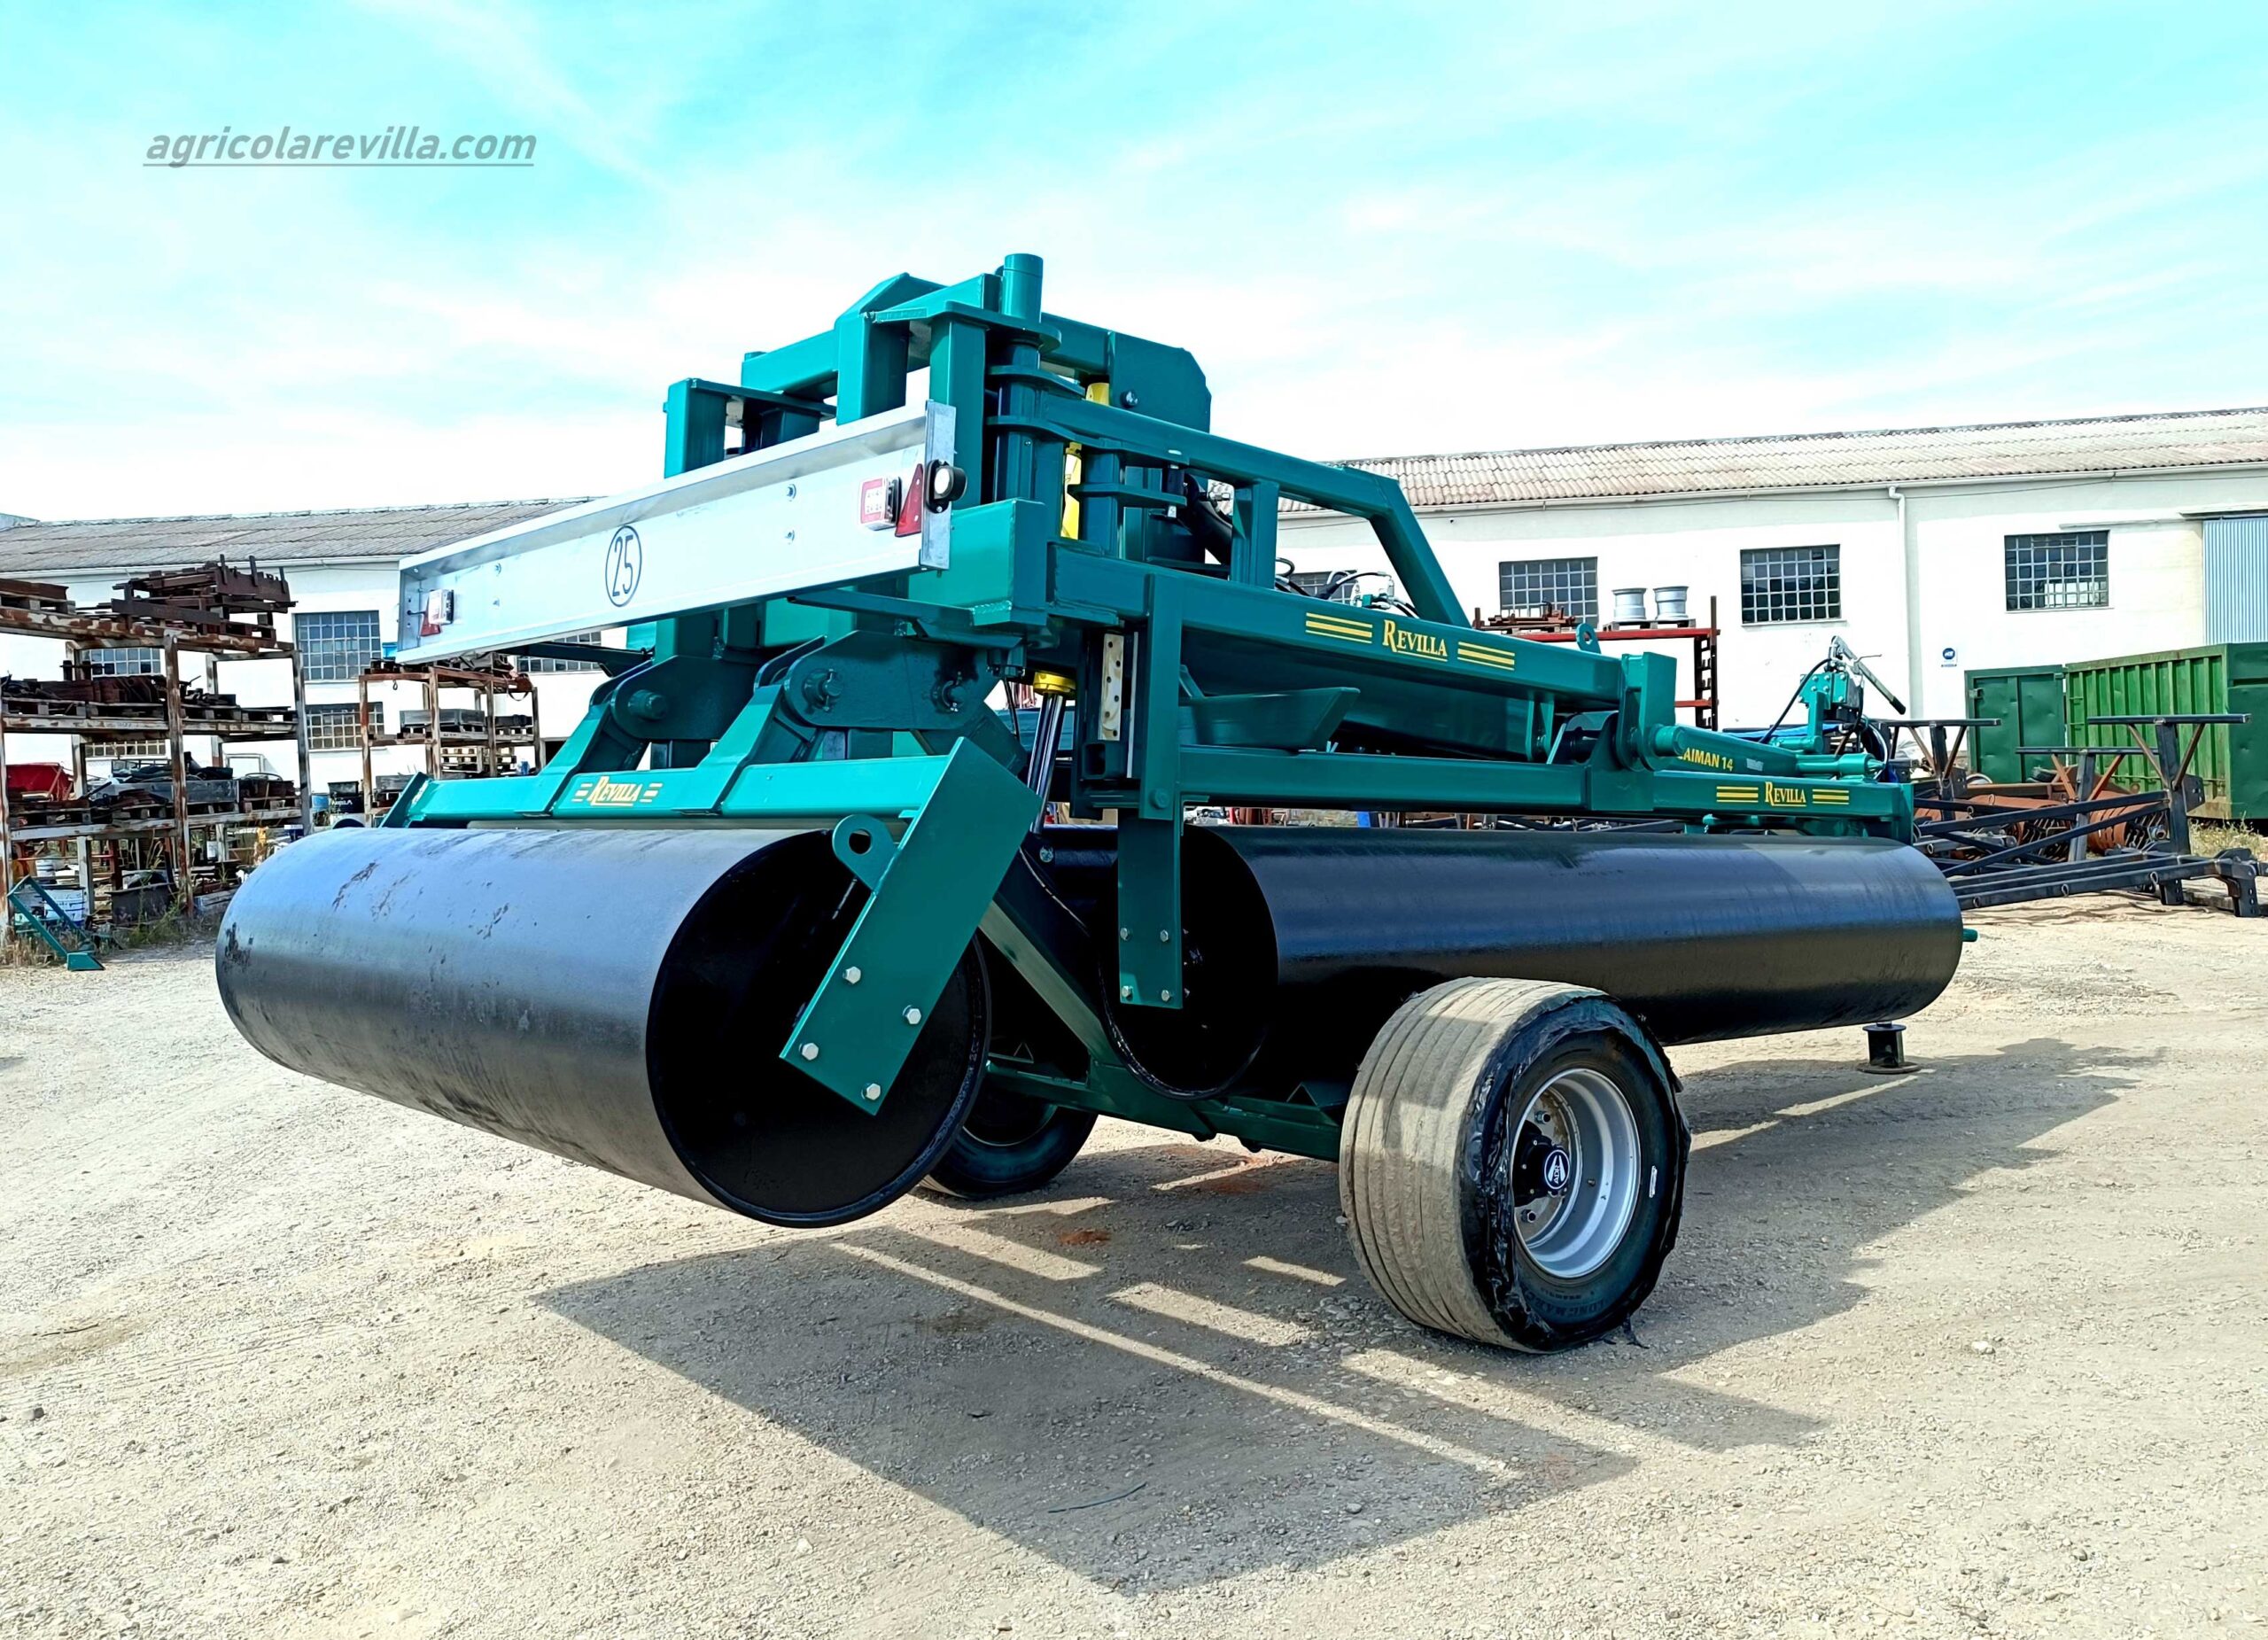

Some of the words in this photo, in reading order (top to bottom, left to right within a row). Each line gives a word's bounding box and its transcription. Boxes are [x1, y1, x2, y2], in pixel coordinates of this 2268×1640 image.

[612, 534, 633, 596] 25
[1382, 619, 1448, 657] REVILLA
[1678, 747, 1720, 768] AIMAN
[1722, 757, 1733, 772] 14
[586, 775, 643, 805] REVILLA
[1765, 781, 1806, 805] REVILLA
